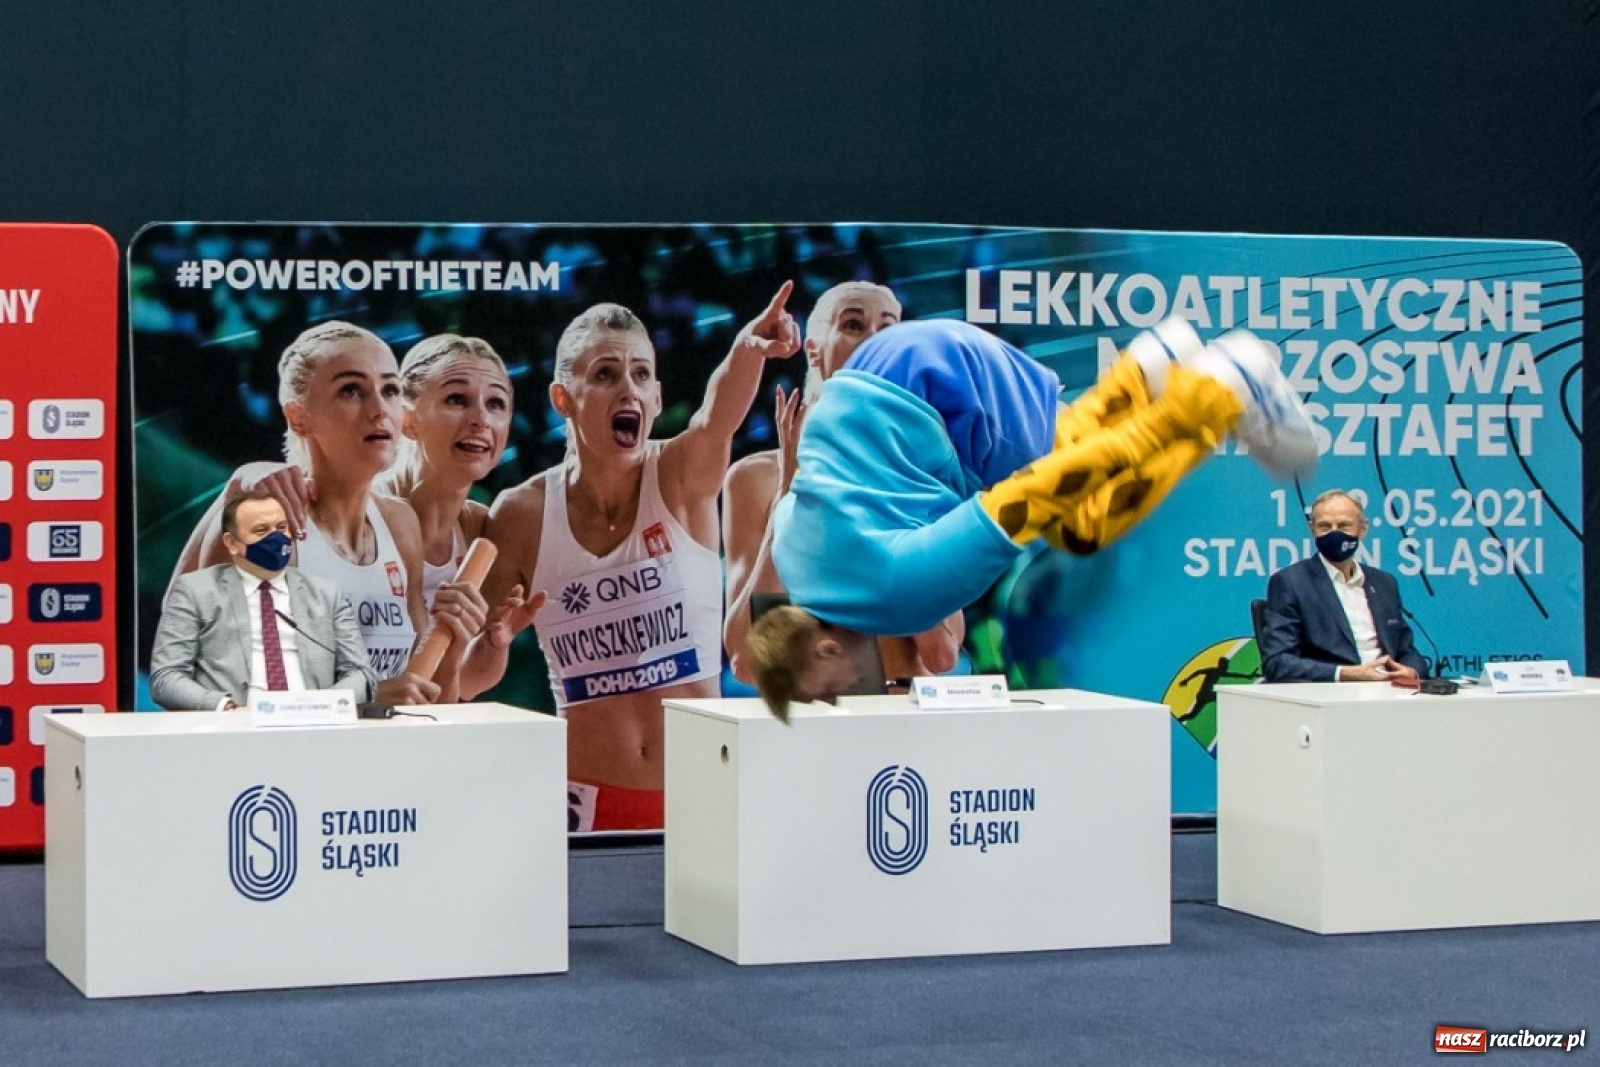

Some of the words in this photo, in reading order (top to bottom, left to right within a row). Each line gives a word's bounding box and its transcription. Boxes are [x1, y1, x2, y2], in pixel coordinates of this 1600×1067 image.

[176, 258, 560, 291] #POWEROFTHETEAM
[966, 269, 1543, 332] LEKKOATLETYCZNE
[1097, 336, 1543, 395] ZOSTWA
[1270, 488, 1287, 527] 1
[1183, 537, 1380, 577] STADIN
[1398, 527, 1544, 586] ŚLĄSKI
[596, 566, 662, 602] QNB
[358, 601, 403, 627] QNB
[550, 601, 688, 668] WYCISZKIEWICZ
[949, 788, 1036, 814] STADION
[321, 807, 417, 836] STADION
[949, 817, 1019, 853] ŚLĄSKI
[321, 839, 400, 877] ŚLĄSKI
